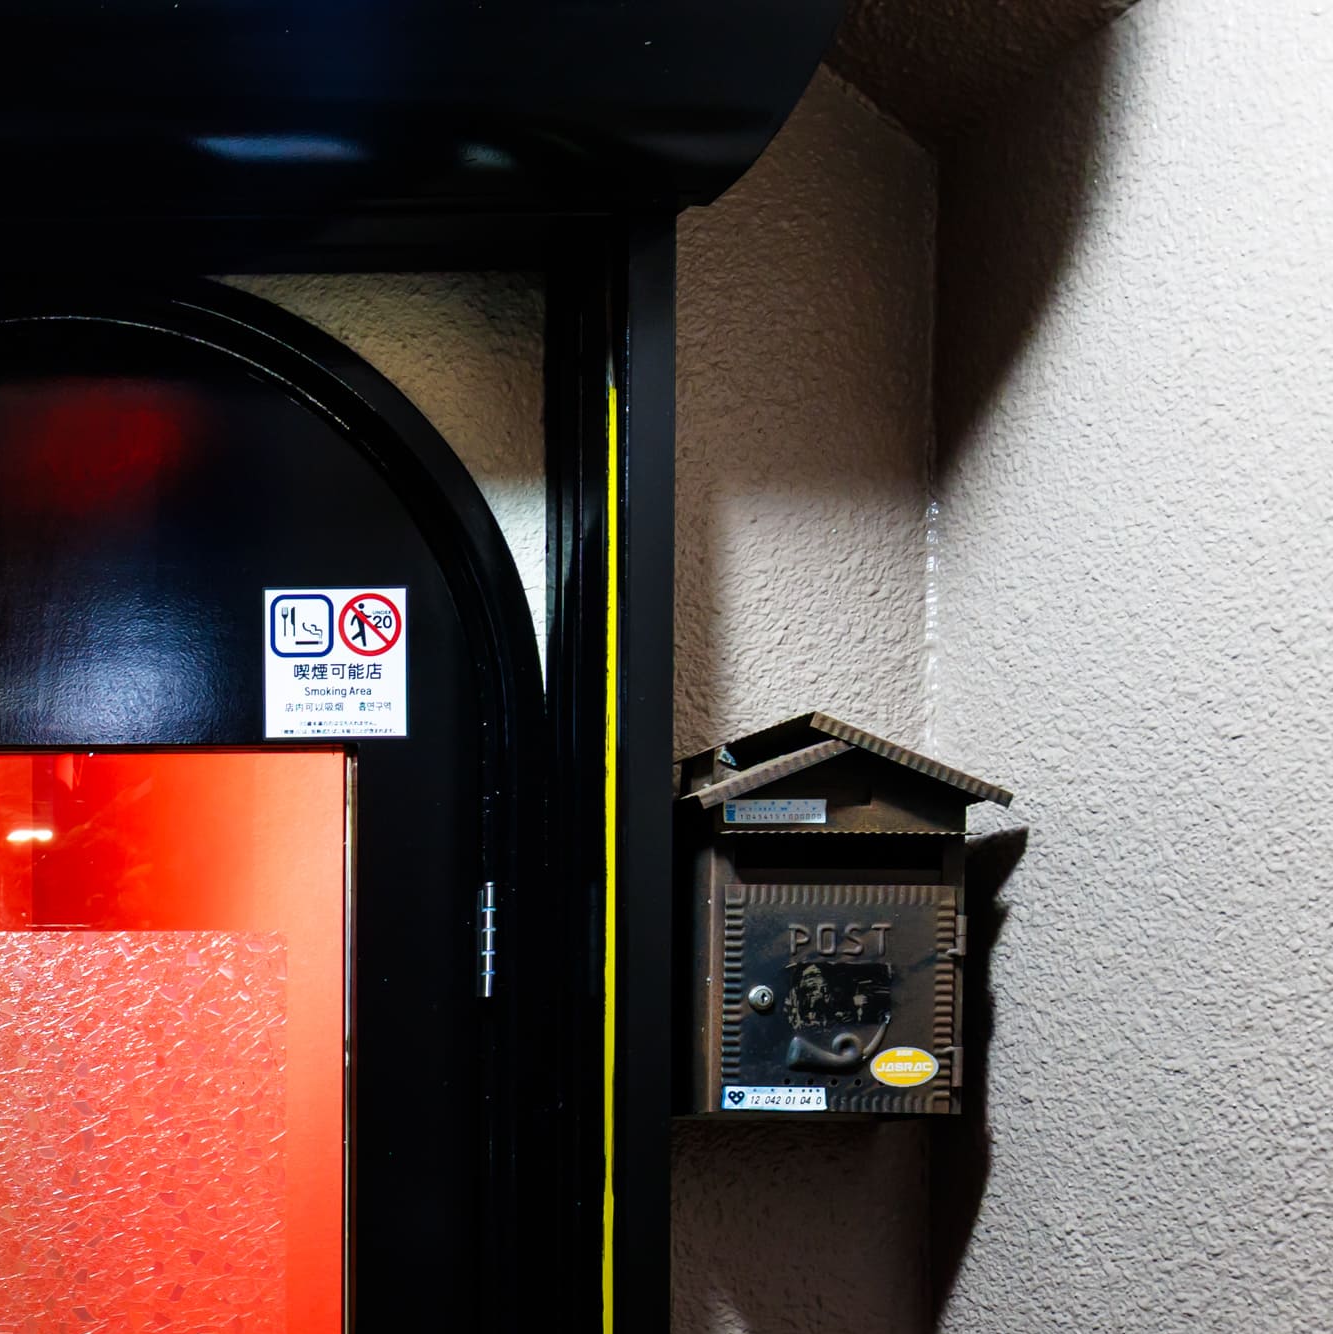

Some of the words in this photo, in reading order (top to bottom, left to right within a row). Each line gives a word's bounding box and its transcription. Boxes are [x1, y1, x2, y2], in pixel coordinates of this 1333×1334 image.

[373, 615, 393, 629] 20
[293, 662, 383, 681] 喫煙可能店
[304, 686, 347, 698] Smoking
[349, 686, 372, 696] Area
[789, 923, 892, 956] POST
[876, 1062, 933, 1072] JASRAC
